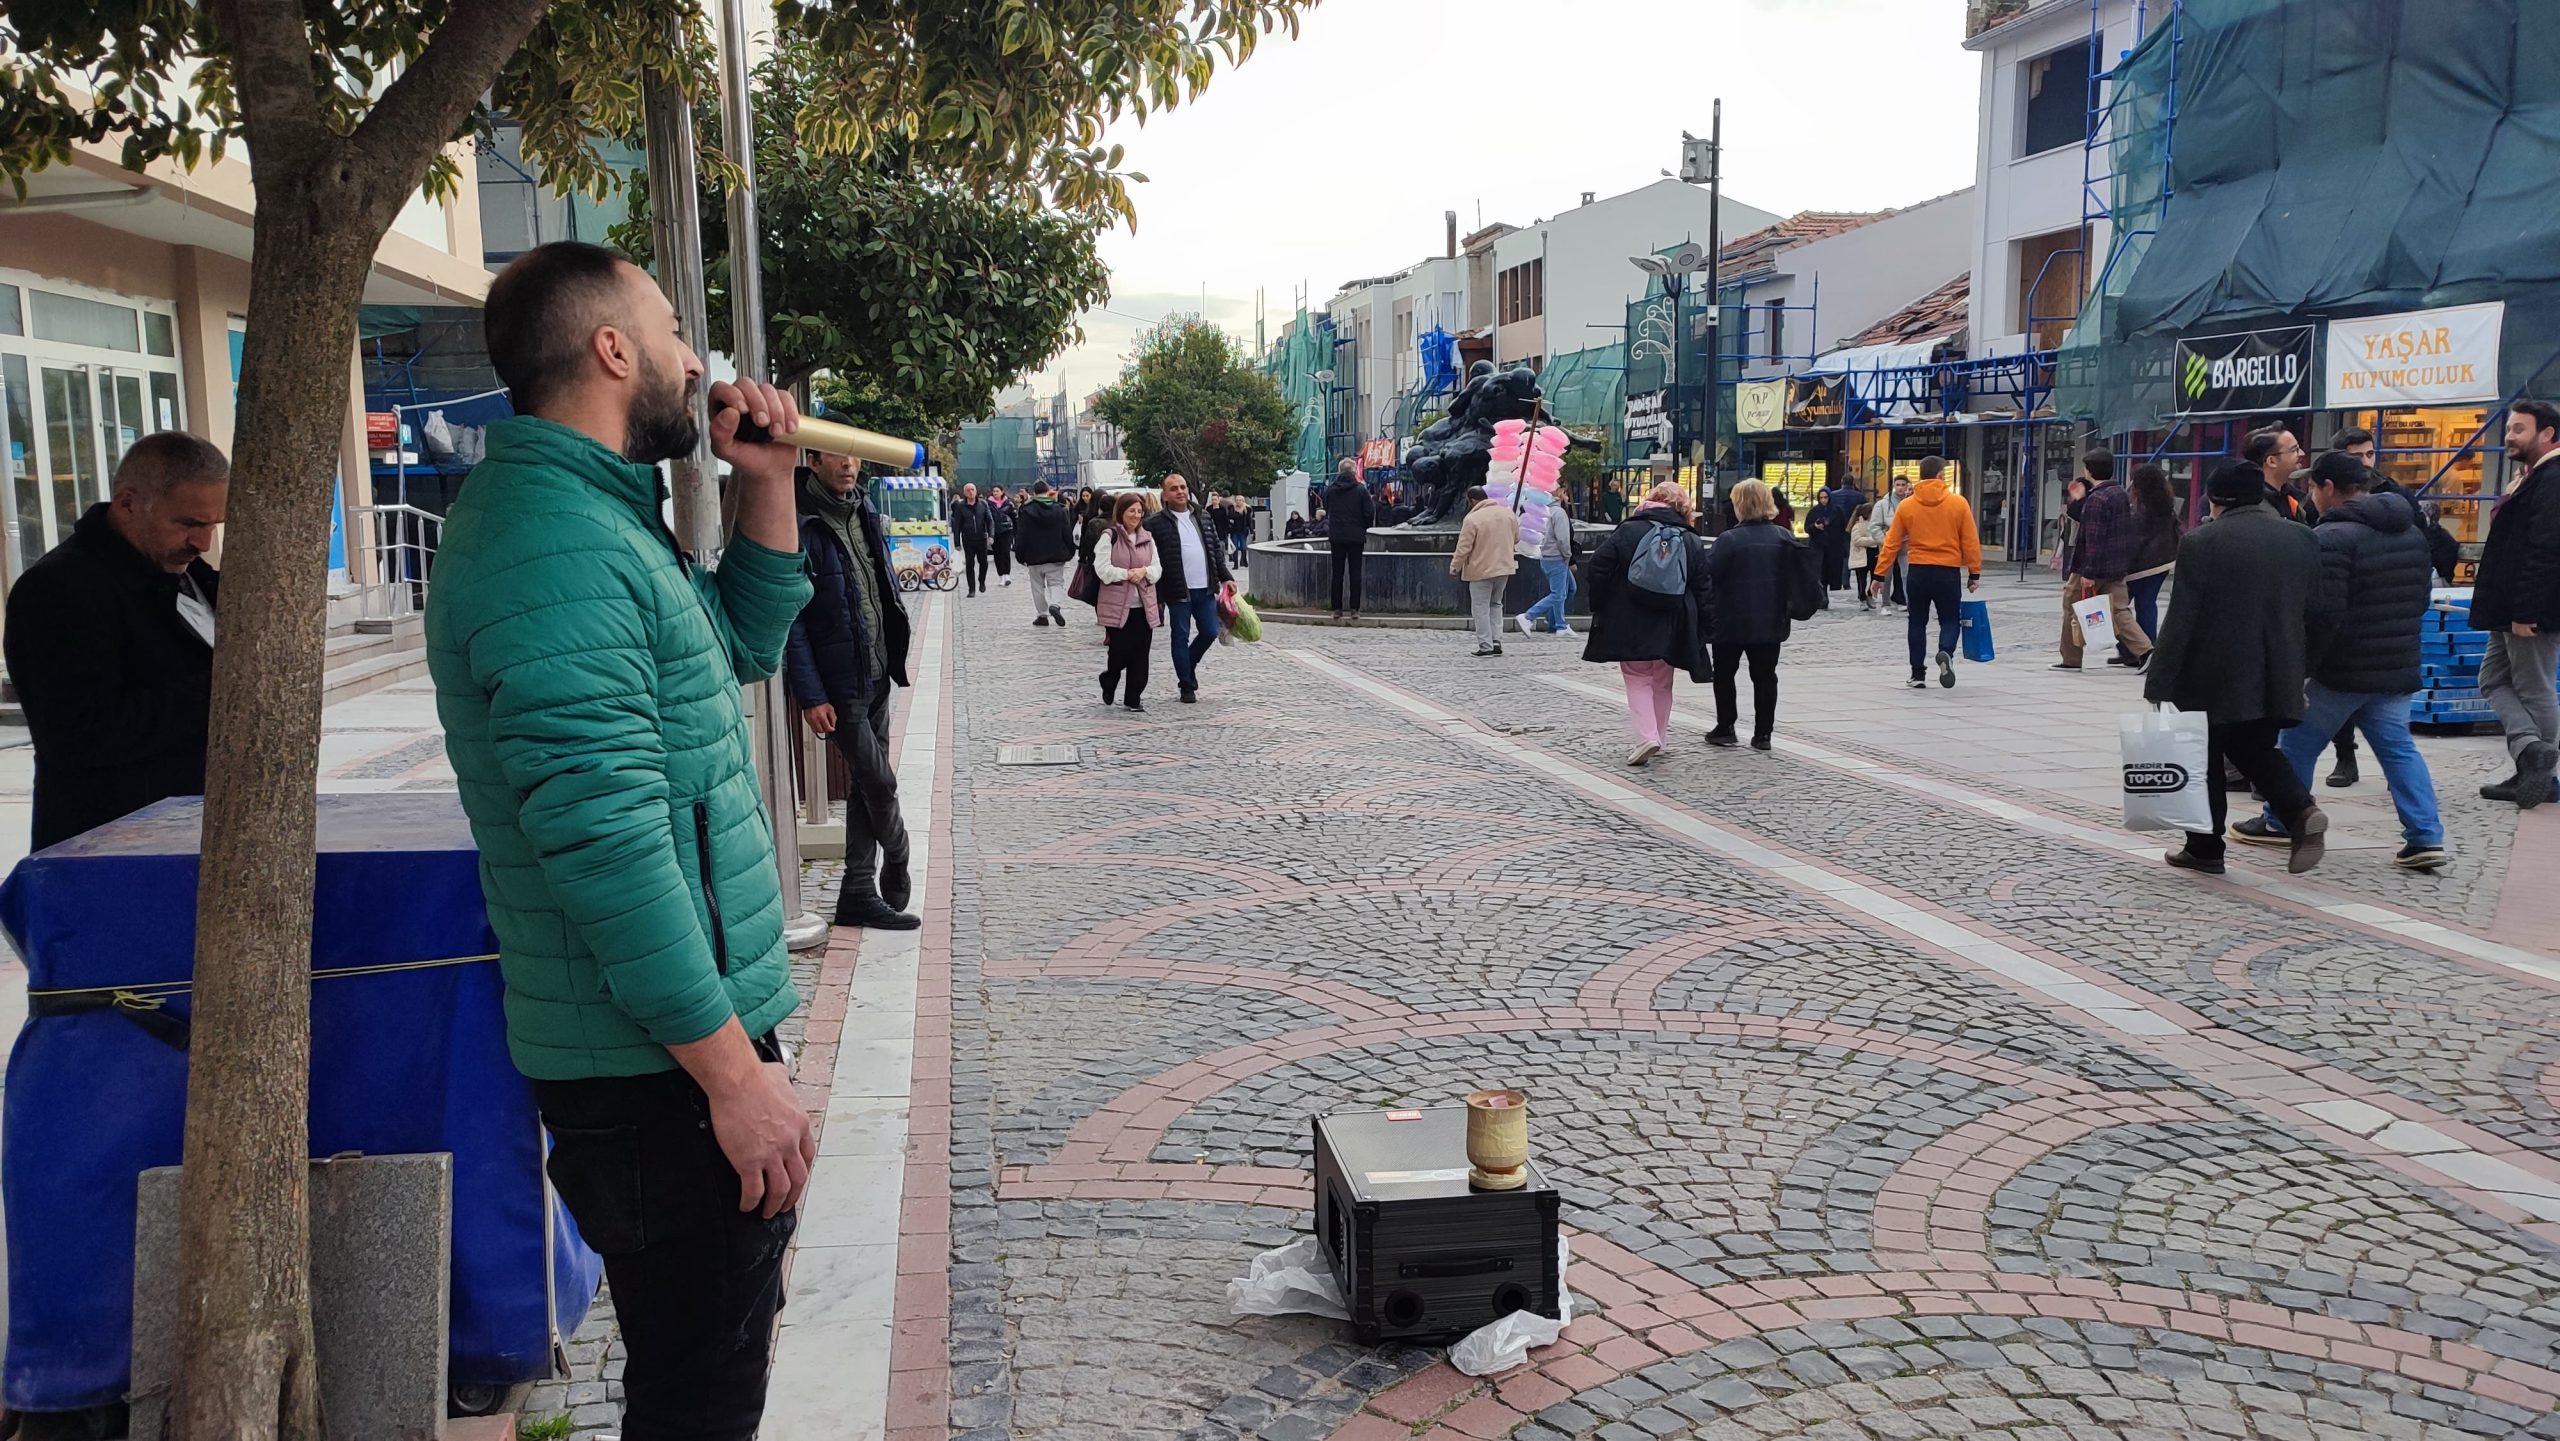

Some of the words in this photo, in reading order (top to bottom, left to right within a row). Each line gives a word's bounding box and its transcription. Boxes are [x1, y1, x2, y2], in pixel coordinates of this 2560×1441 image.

[2363, 327, 2451, 365] YAŞAR
[2212, 353, 2297, 389] BARGELLO
[2341, 364, 2474, 390] KUYUMCULUK
[2127, 773, 2174, 786] TOPÇU
